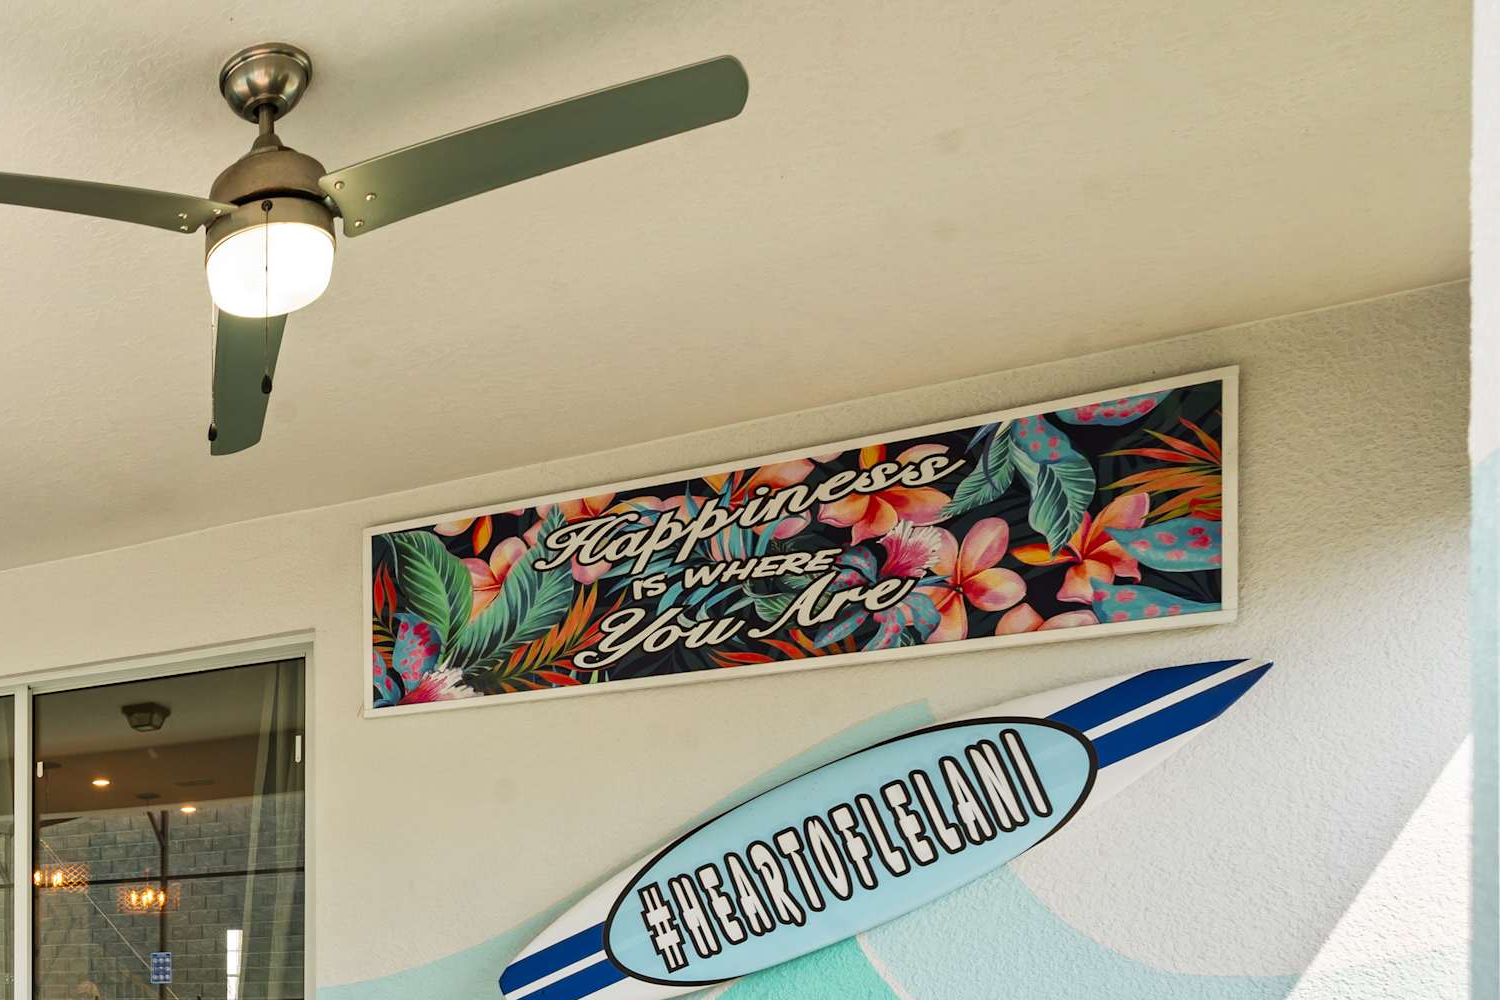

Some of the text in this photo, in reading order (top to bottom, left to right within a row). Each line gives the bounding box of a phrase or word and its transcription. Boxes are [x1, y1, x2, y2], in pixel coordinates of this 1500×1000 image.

[535, 456, 966, 575] Happiness
[573, 570, 924, 669] You Are
[632, 548, 843, 600] IS WHERE
[636, 728, 1053, 973] #HEARTOFLELANI
